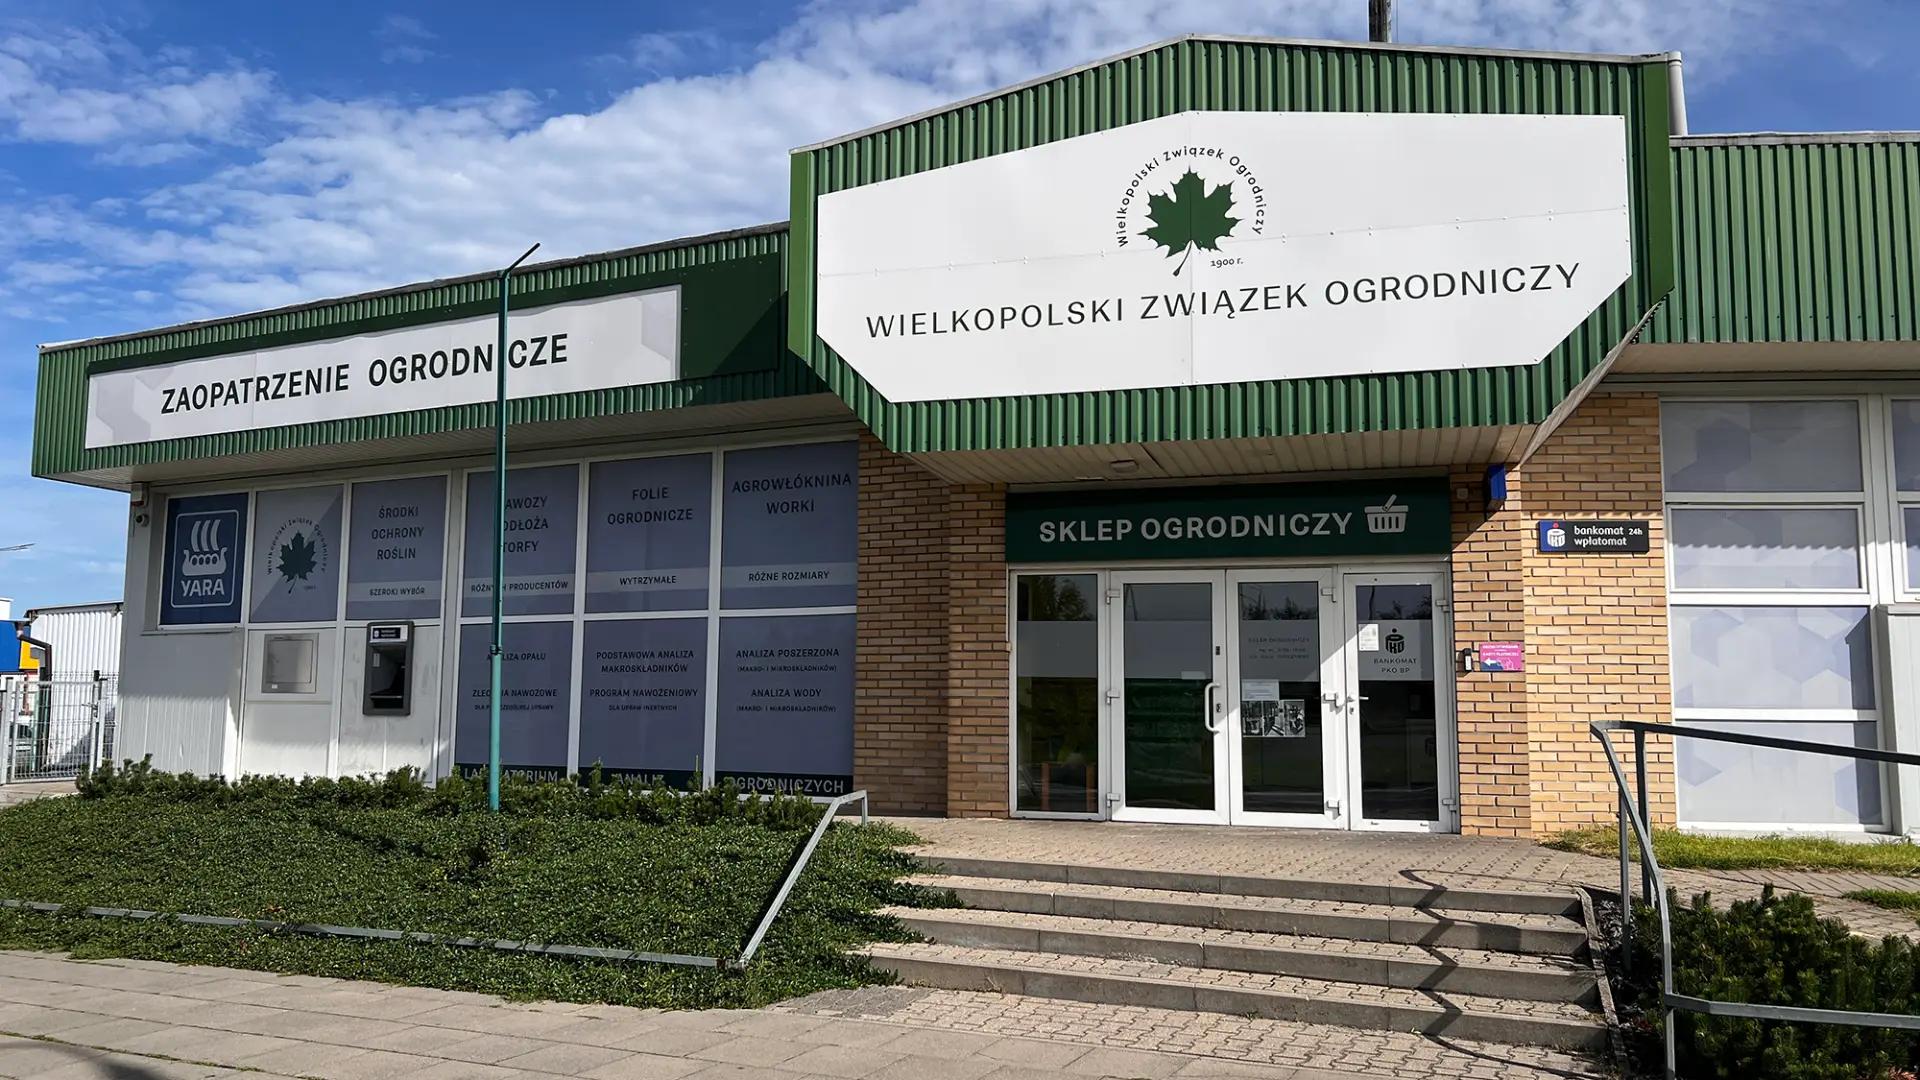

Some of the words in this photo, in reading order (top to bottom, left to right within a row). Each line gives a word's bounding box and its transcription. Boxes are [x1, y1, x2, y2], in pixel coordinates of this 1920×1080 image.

[1116, 158, 1159, 247] Wielkopolski
[1163, 146, 1224, 162] Związek
[1229, 156, 1267, 235] Ogrodniczy
[1210, 258, 1235, 268] 1900
[866, 297, 1124, 339] WIELKOPOLSKI
[1140, 283, 1308, 321] ZWIĄZEK
[1325, 262, 1580, 306] OGRODNICZY
[161, 363, 350, 415] ZAOPATRZENIE
[368, 333, 568, 387] OGRODNCZE
[732, 472, 852, 494] AGROWŁÓKNINA
[632, 486, 669, 501] FOLIE
[505, 496, 548, 510] AWOZY
[766, 499, 815, 515] WORKI
[378, 506, 419, 519] ŚRODKI
[607, 508, 693, 525] OGRODNICZE
[503, 516, 549, 532] ODŁOŻA
[1039, 519, 1133, 543] SKLEP
[1140, 512, 1353, 540] OGRODNICZY
[1574, 525, 1624, 536] bankomat
[1628, 528, 1643, 536] 24h
[371, 526, 424, 540] OCHRONY
[376, 547, 416, 560] ROŚLIN
[619, 574, 677, 586] WYTRZYMAŁE
[748, 570, 779, 582] RÓŻNE
[781, 570, 830, 581] ROZMIARY
[181, 578, 225, 597] YARA
[369, 587, 398, 596] SZEROKI
[399, 586, 425, 595] WYBÓR
[508, 580, 569, 591] PRODUCENTÓW
[486, 653, 518, 661] ALIZA
[596, 651, 655, 660] PODSTAWOWA
[658, 650, 694, 659] ANALIZA
[736, 649, 775, 658] ANALIZA
[778, 648, 840, 658] POSZERZONA
[601, 663, 688, 673] MAKROSKŁADNIKÓW
[589, 688, 630, 697] PROGRAM
[751, 688, 790, 698] ANALIZA
[793, 688, 822, 697] WODY
